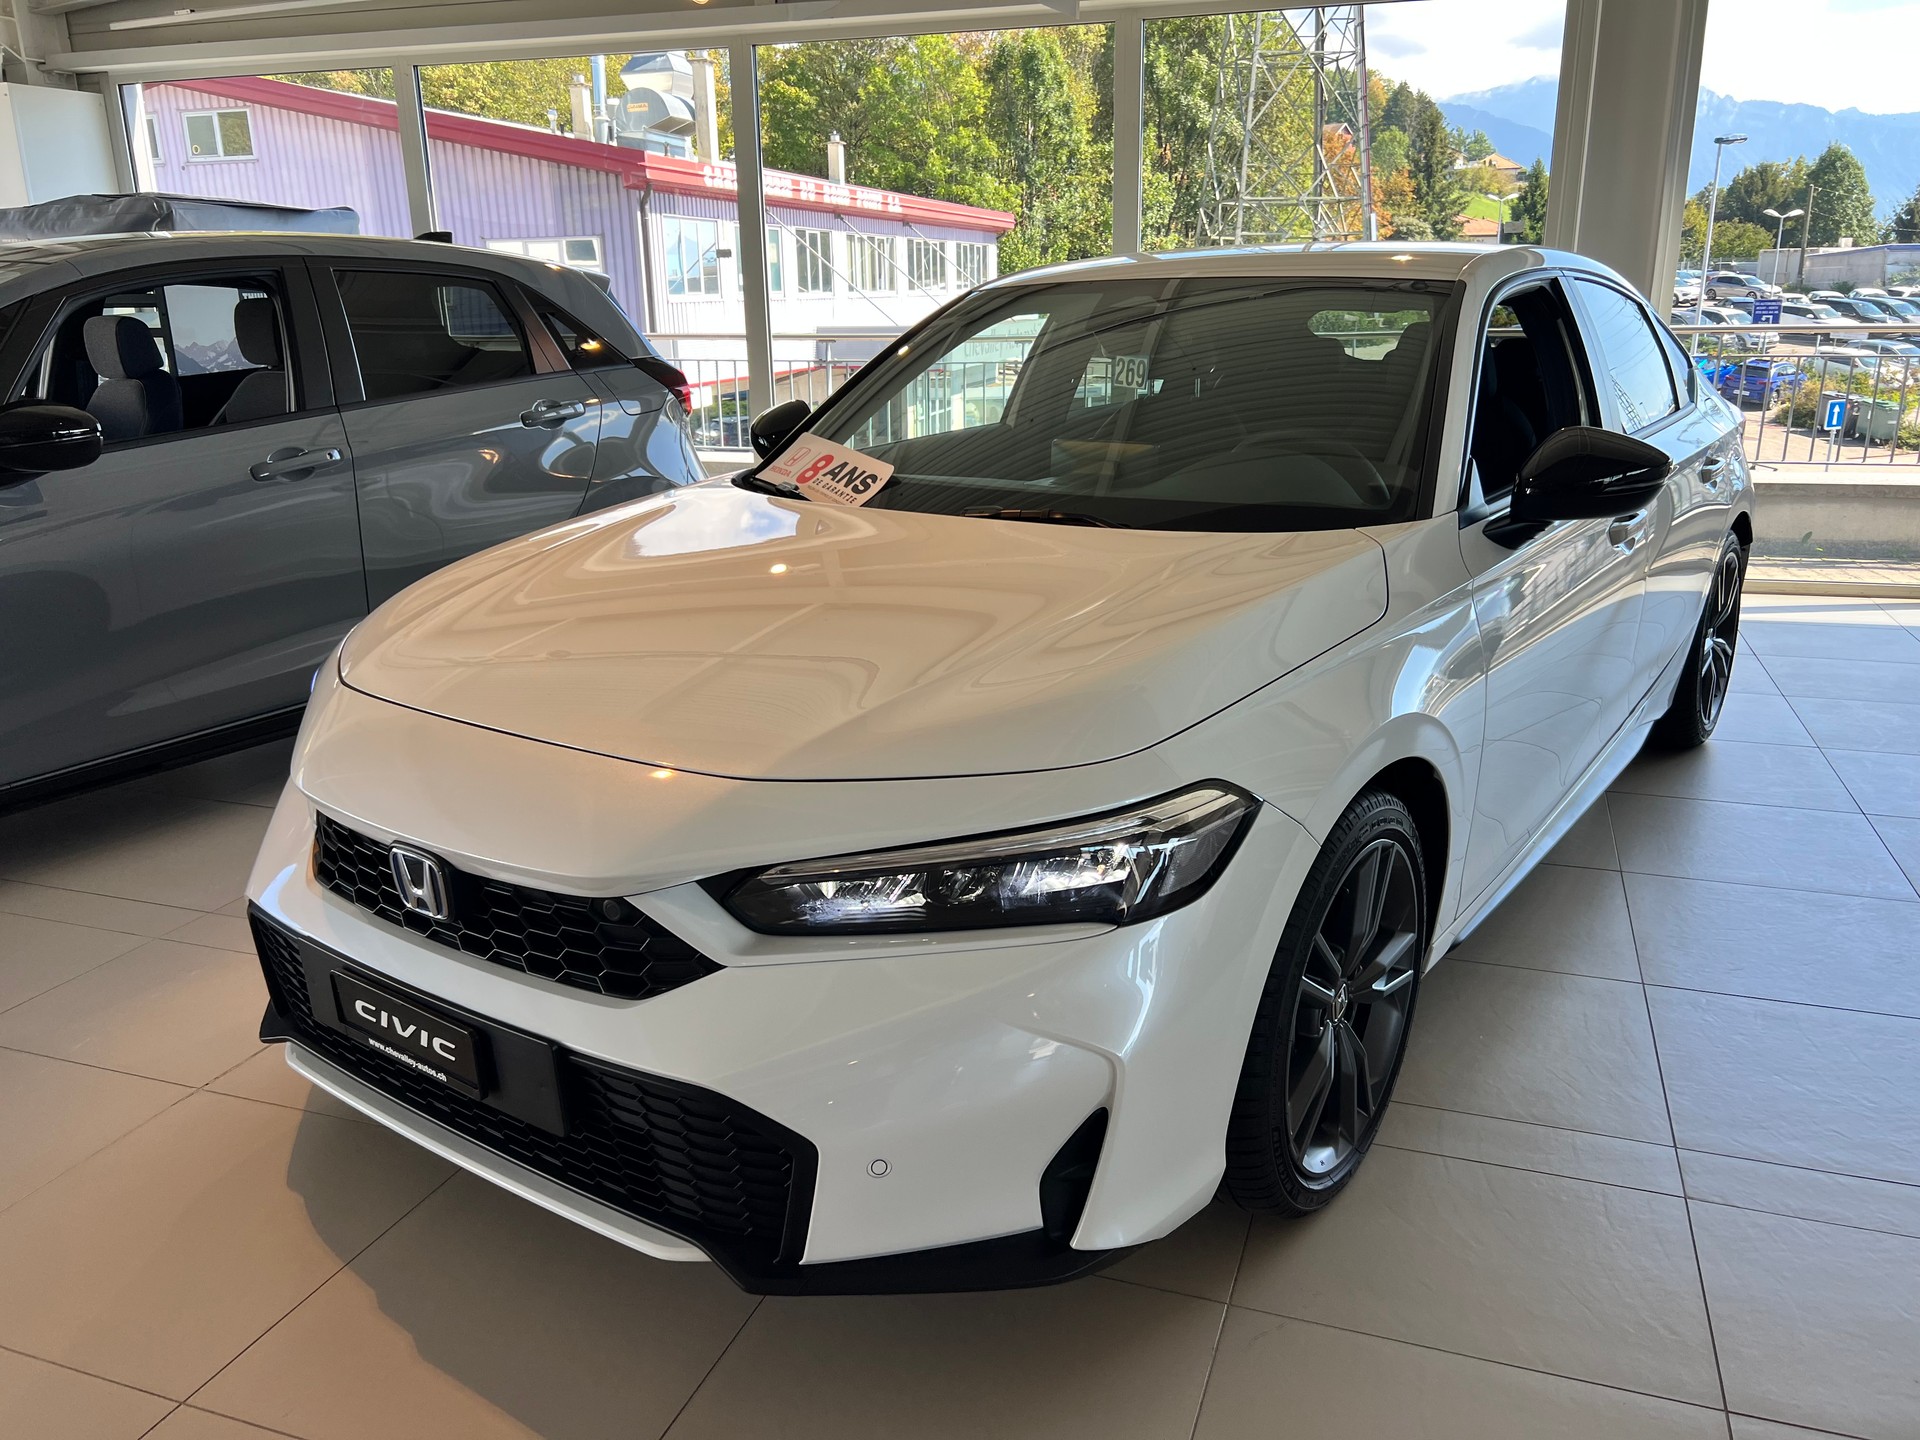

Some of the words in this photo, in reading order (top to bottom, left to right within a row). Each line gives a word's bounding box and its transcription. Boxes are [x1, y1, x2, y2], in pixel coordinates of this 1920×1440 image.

[1115, 357, 1146, 387] 269
[795, 454, 835, 485] 8
[822, 461, 878, 495] ANS
[812, 478, 823, 486] DE
[821, 482, 857, 504] GARANTIE
[355, 999, 456, 1062] CIVIC
[368, 1037, 448, 1082] www.chevalley-autos.ch
